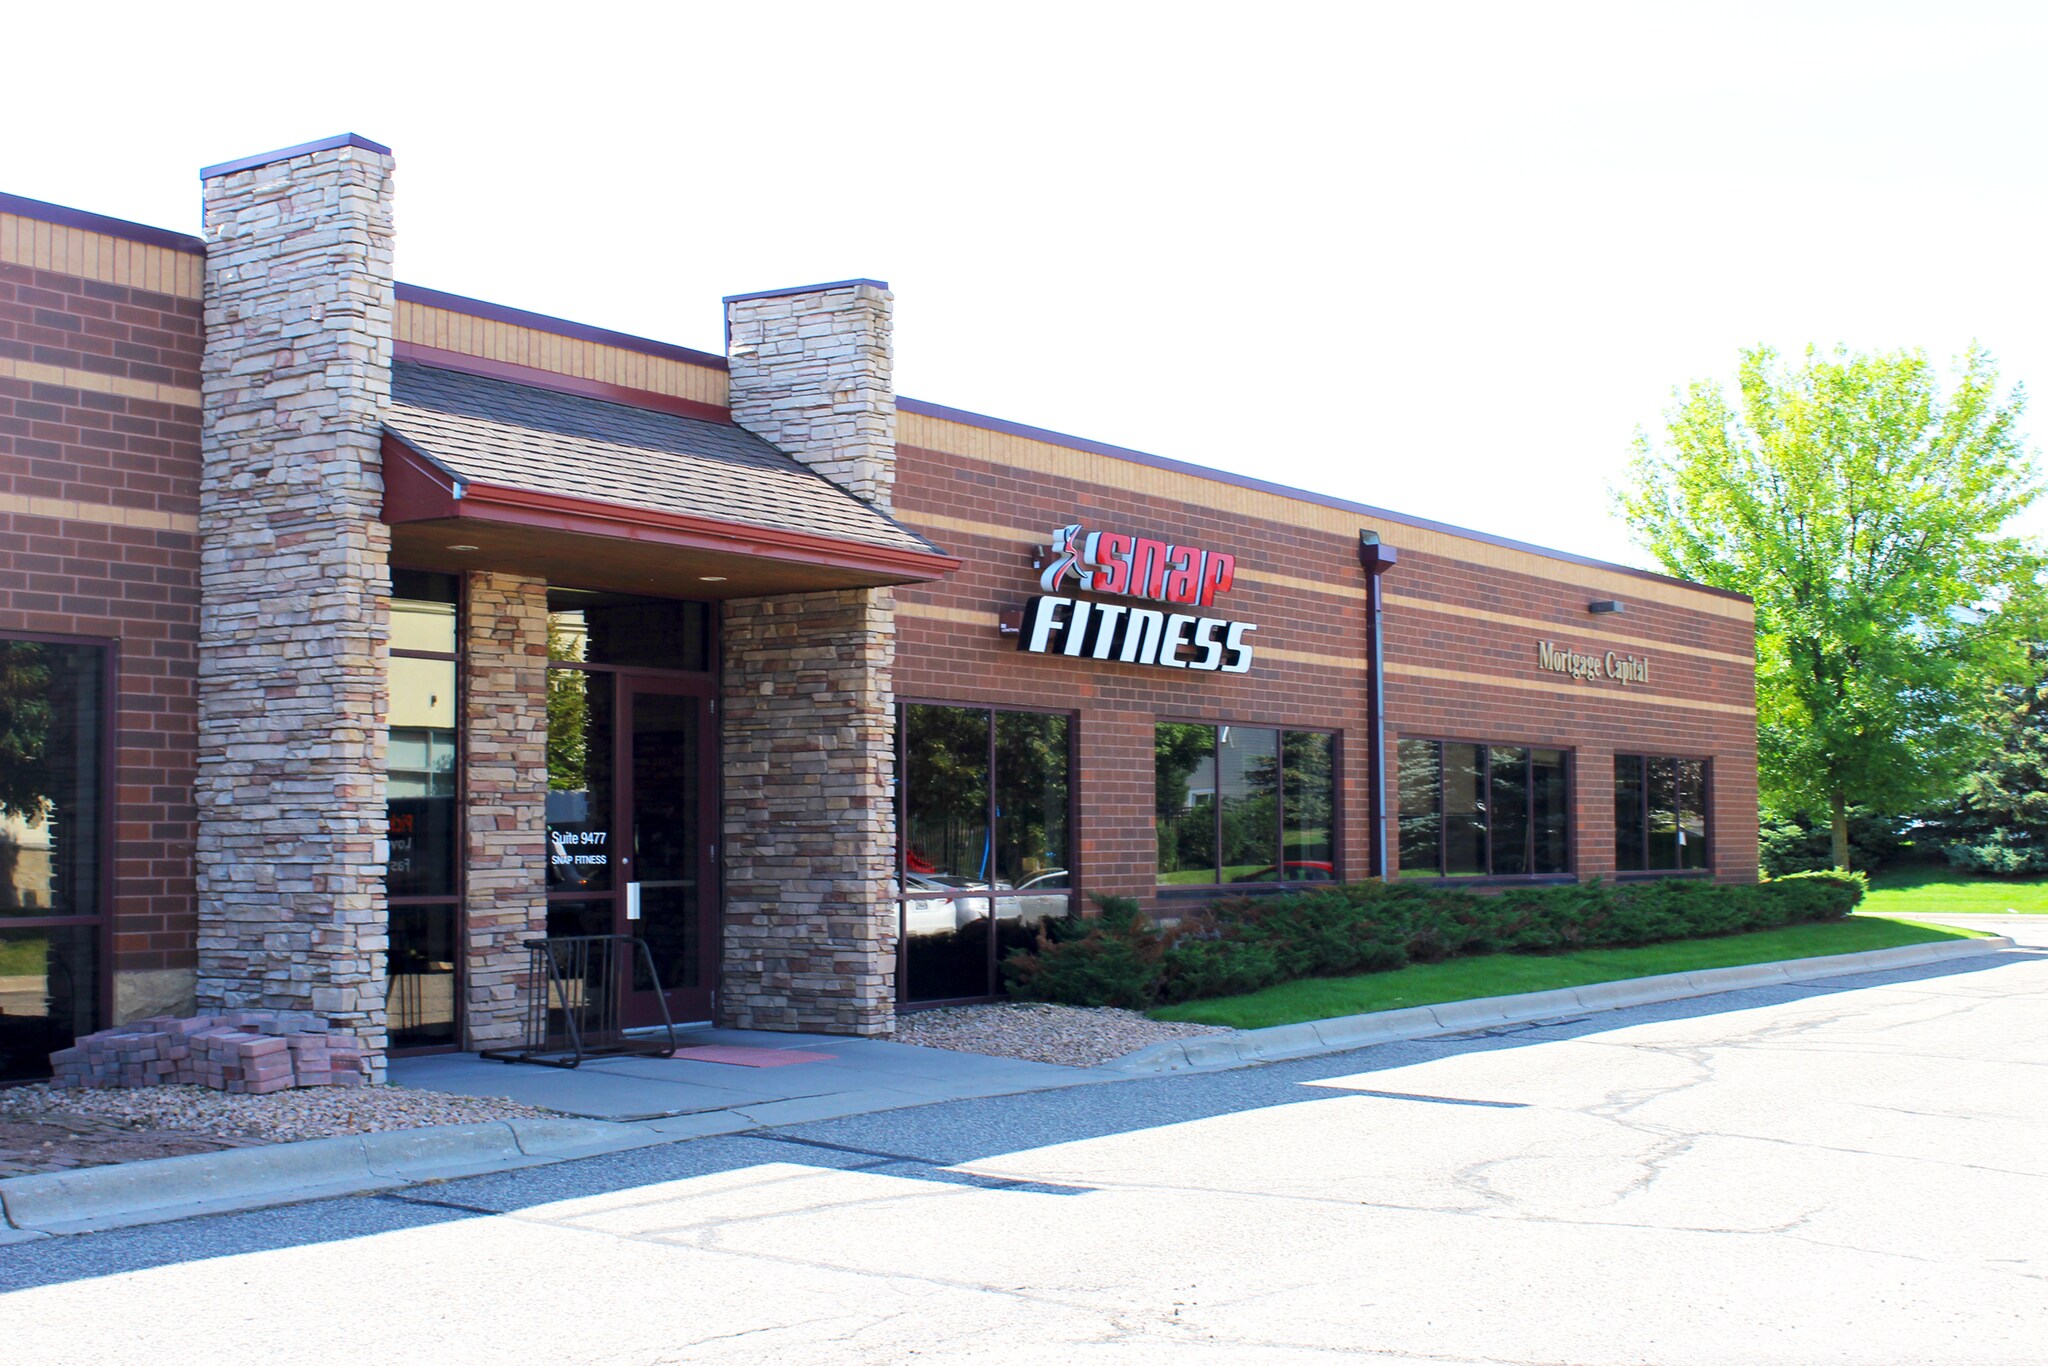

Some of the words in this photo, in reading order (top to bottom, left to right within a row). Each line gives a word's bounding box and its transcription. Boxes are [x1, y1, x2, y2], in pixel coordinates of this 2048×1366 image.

[1538, 641, 1601, 681] Mortgage
[1604, 651, 1649, 685] Capital
[551, 831, 579, 844] Suite
[580, 832, 607, 845] 9477
[551, 855, 573, 865] SNAP
[575, 855, 607, 865] FITNESS
